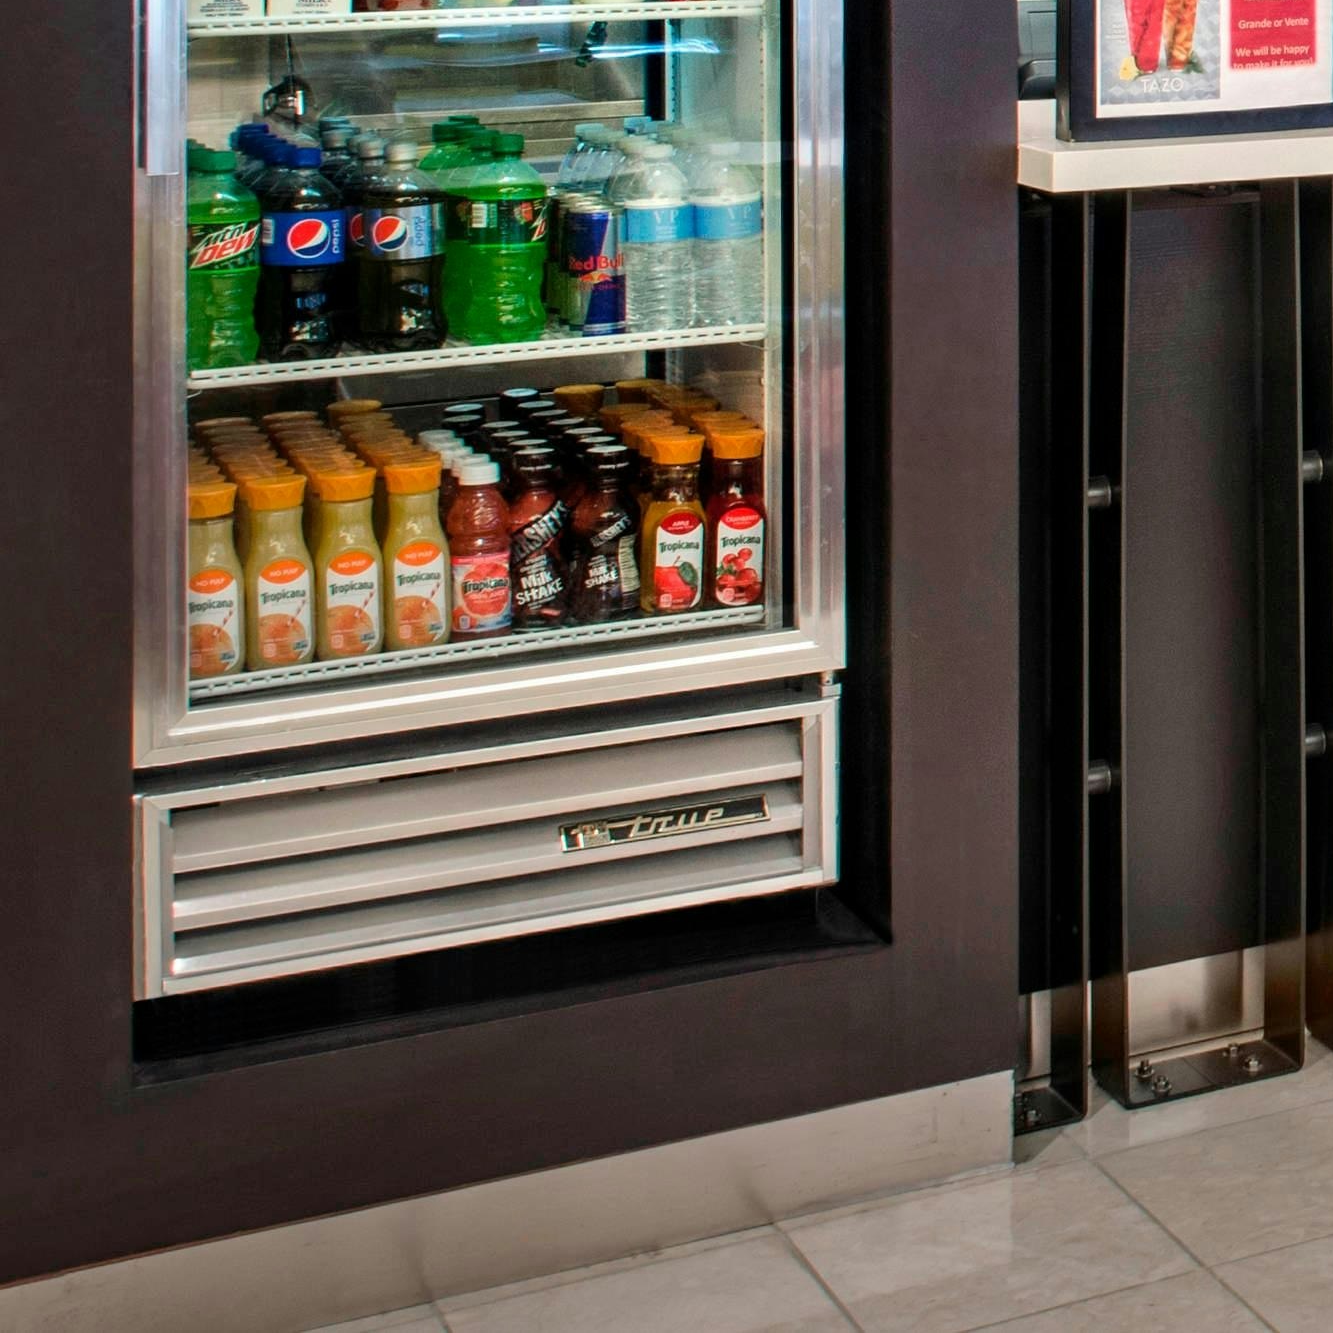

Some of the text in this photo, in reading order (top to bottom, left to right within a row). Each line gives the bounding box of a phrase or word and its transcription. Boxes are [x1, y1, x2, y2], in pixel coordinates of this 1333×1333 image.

[1238, 16, 1309, 30] Grande or Vente
[1235, 44, 1310, 57] We will be happy
[1140, 76, 1184, 93] TAZO
[332, 218, 340, 254] pepsi
[597, 254, 625, 270] Bull
[659, 540, 700, 554] Tropicana
[721, 535, 761, 548] Tropicana
[397, 571, 441, 586] Tropicana
[462, 577, 509, 593] Tropicana
[521, 571, 553, 589] Milk
[585, 569, 619, 589] SHAKE
[329, 580, 374, 596] Tropicana
[516, 578, 564, 605] SHAKE
[260, 589, 306, 604] Tropicana
[188, 599, 234, 613] Tropicana
[629, 807, 725, 838] true
